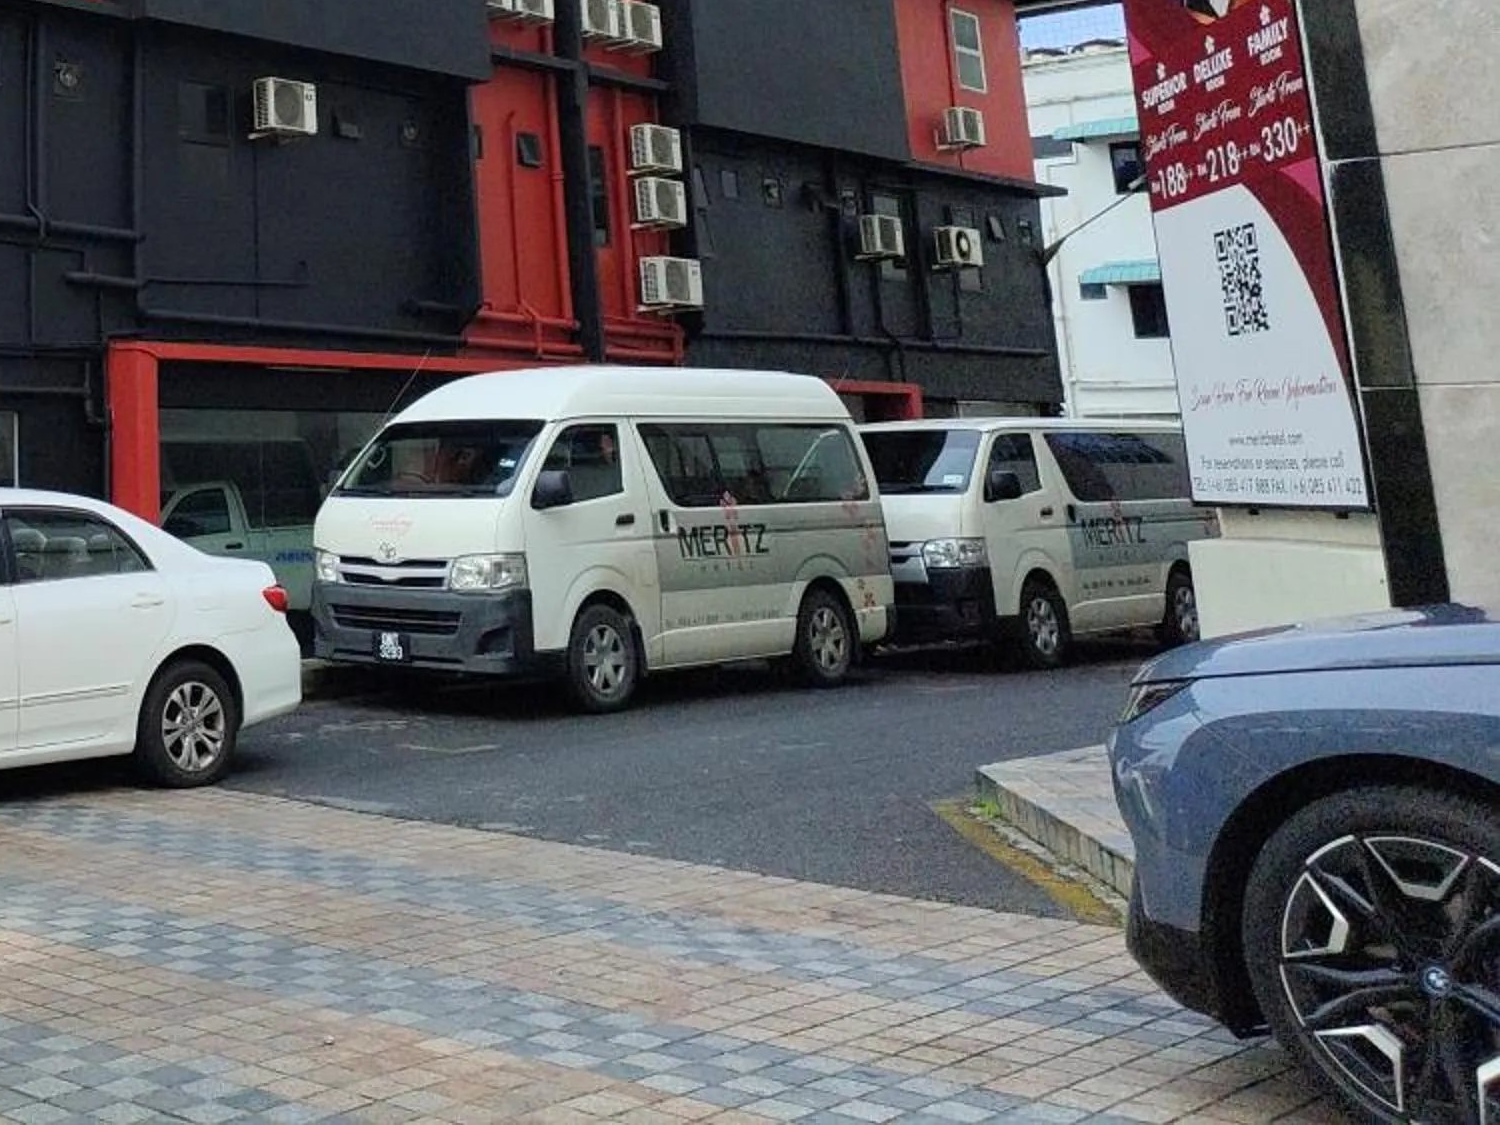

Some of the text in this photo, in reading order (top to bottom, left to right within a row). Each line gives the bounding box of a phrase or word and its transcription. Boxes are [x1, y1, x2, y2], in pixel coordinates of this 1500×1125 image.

[1247, 17, 1288, 57] FAMILY
[1193, 47, 1234, 84] DELUXE
[1142, 72, 1187, 109] SUPERIOR
